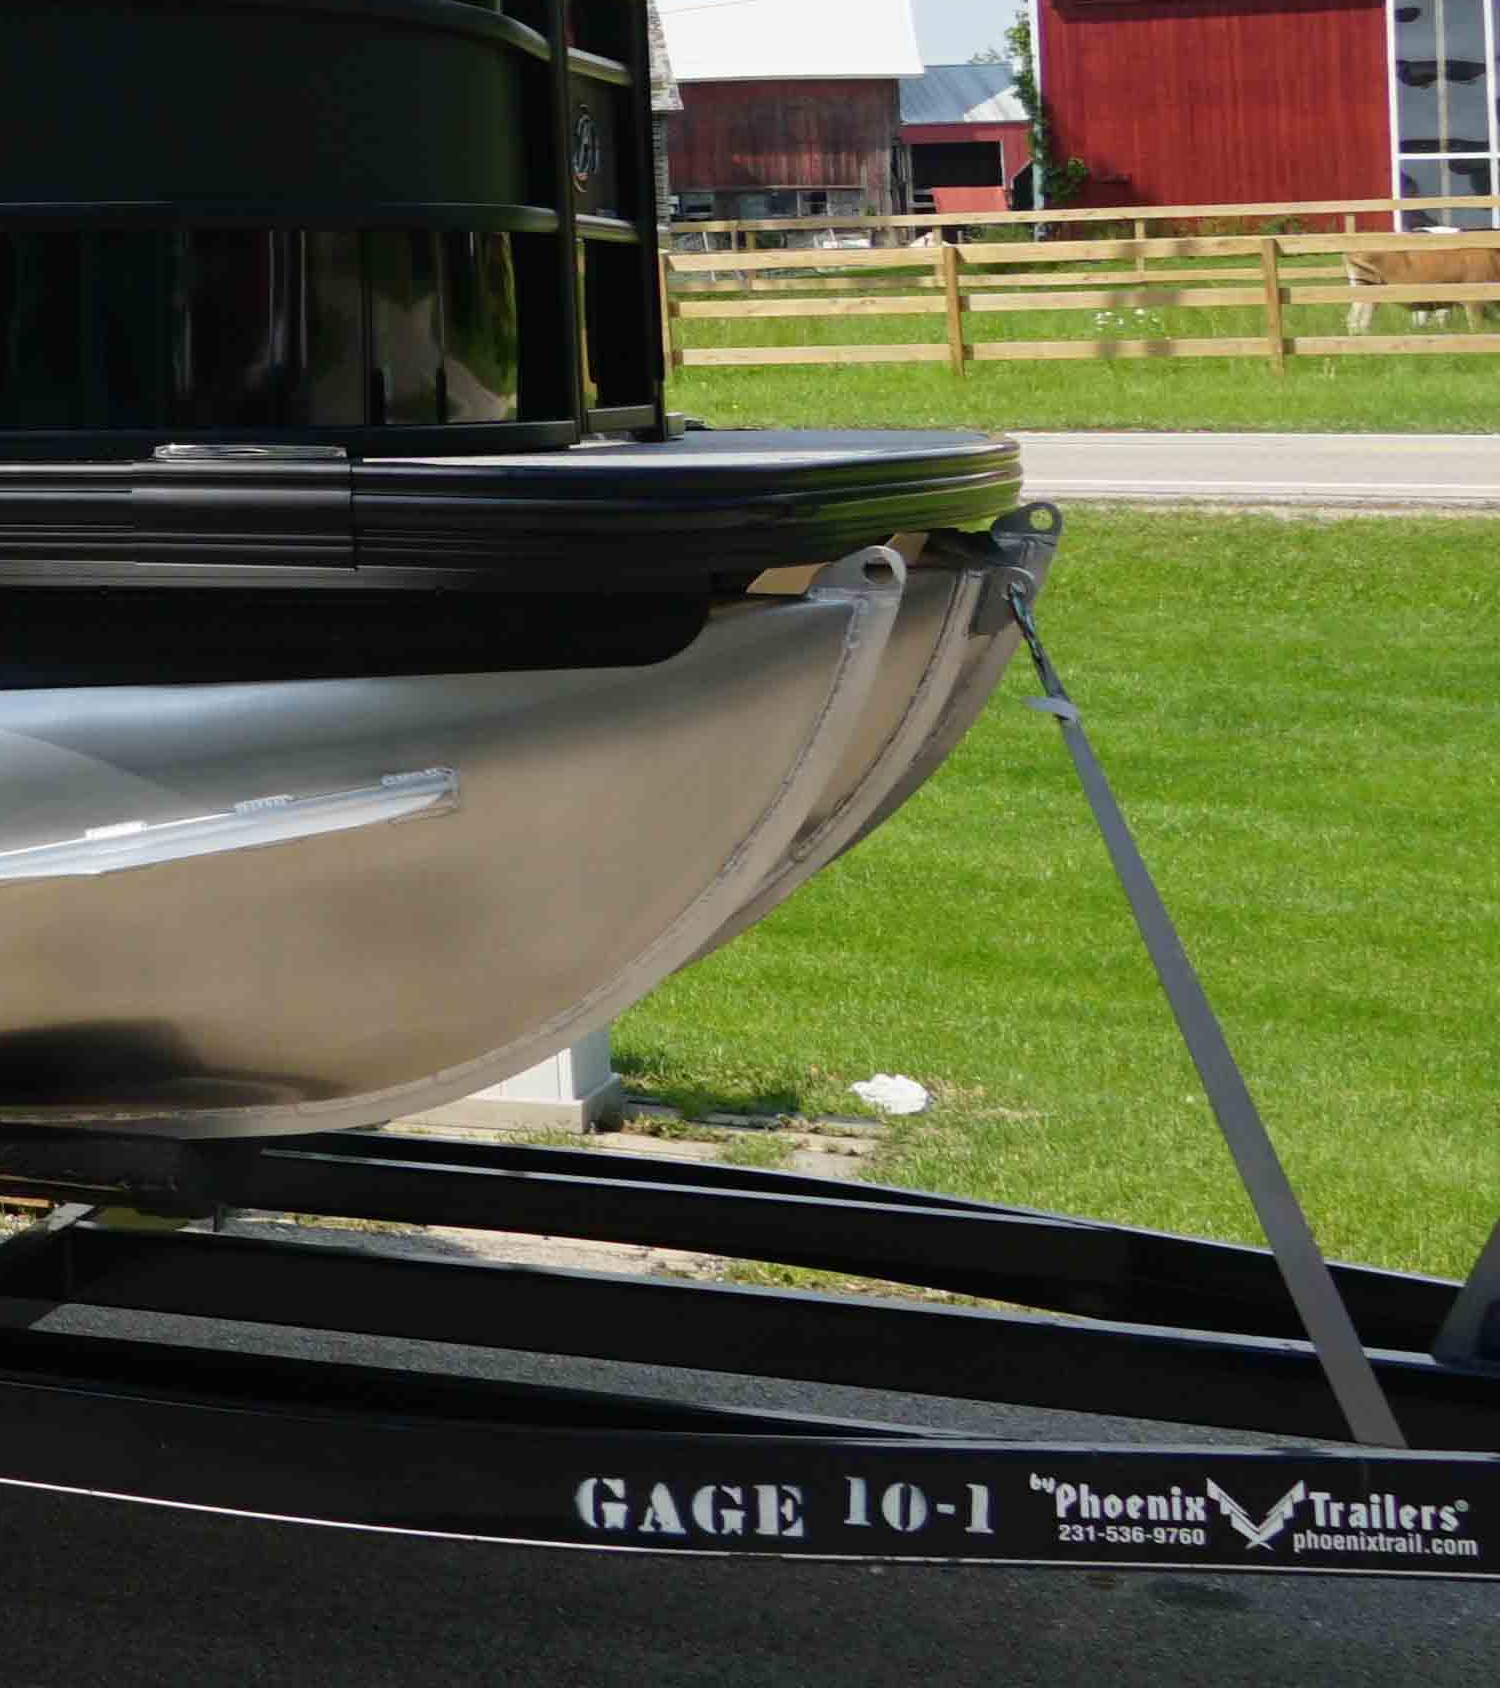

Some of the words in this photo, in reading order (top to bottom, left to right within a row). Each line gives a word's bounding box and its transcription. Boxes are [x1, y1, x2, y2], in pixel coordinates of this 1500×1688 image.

[573, 1476, 805, 1538] GAGE
[842, 1474, 996, 1536] 10-1
[1029, 1472, 1056, 1494] by
[1055, 1482, 1207, 1522] Phoenix
[1058, 1523, 1206, 1546] 231-536-9760
[1292, 1529, 1478, 1557] phoenixtrail.com
